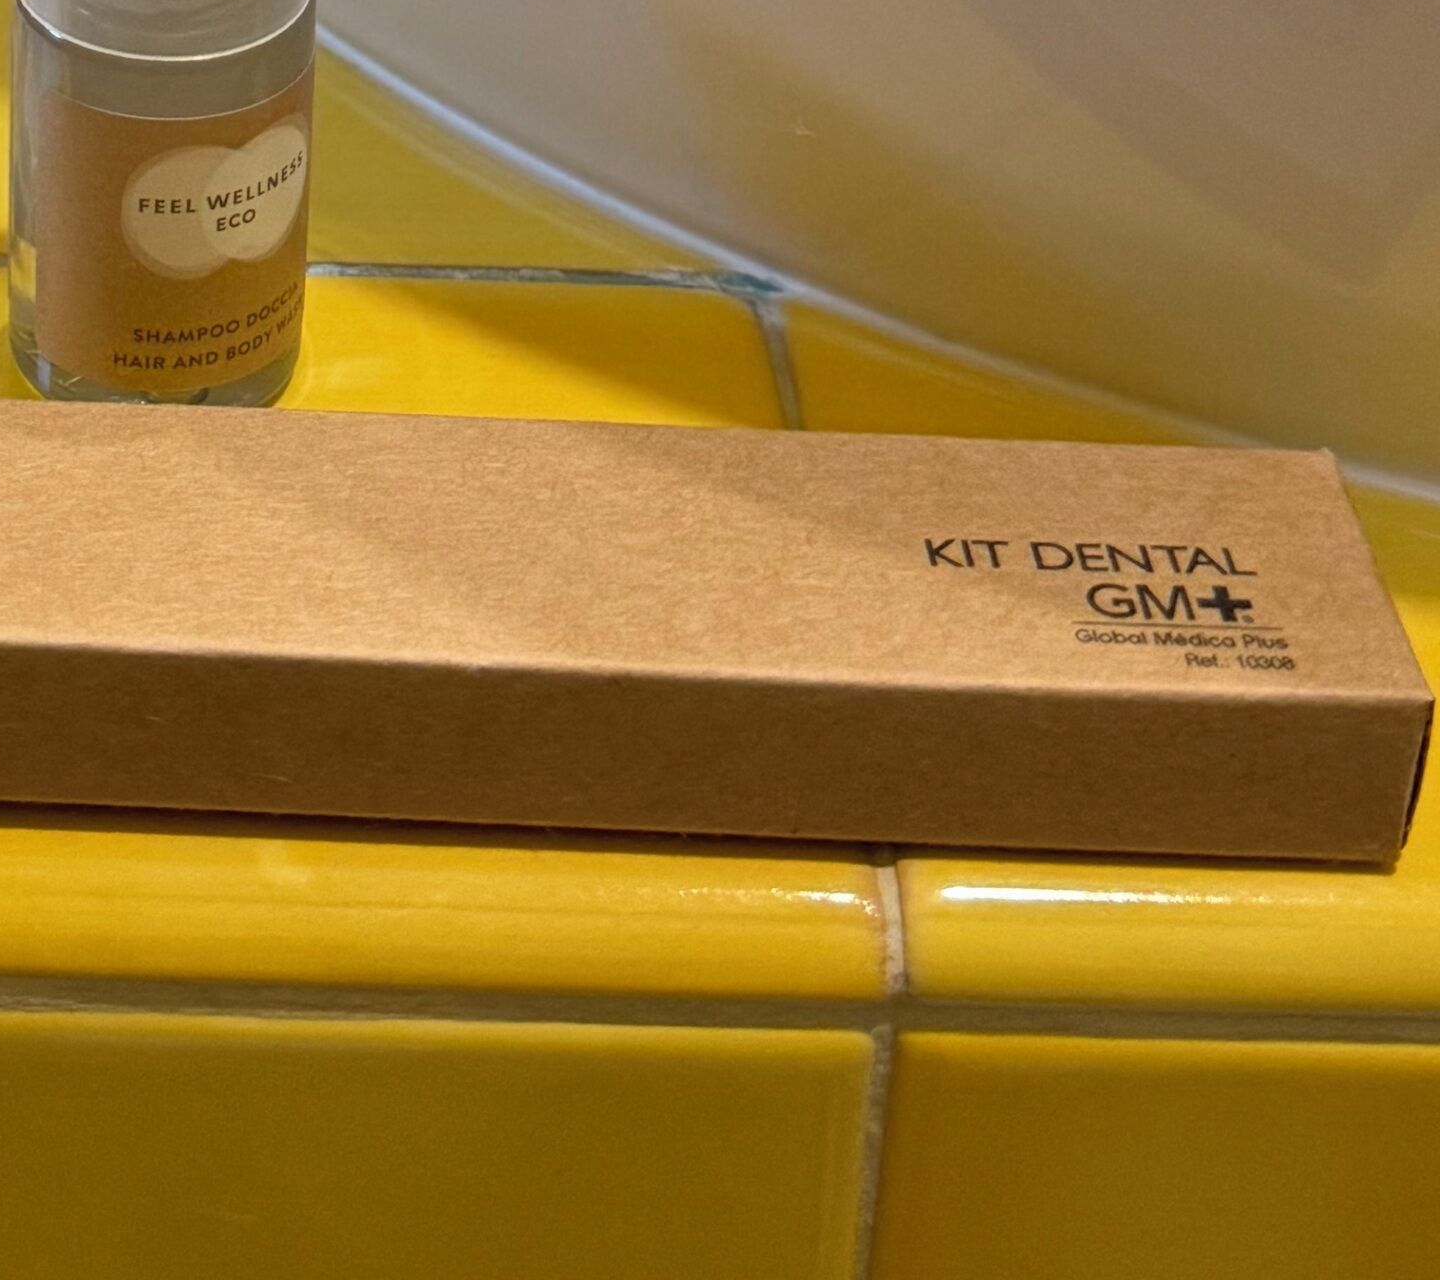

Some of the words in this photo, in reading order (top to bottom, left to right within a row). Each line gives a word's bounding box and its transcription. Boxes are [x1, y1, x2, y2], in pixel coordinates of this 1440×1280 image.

[139, 198, 197, 214] FEEL
[206, 150, 304, 212] WELLNESS
[216, 208, 257, 232] ECO
[133, 319, 240, 345] SHAMPOO
[113, 353, 166, 370] HAIR
[173, 351, 218, 370] AND
[226, 327, 273, 361] BODY
[924, 538, 1009, 569] KIT
[1030, 541, 1258, 577] DENTAL
[1074, 628, 1147, 646] Global
[1242, 633, 1289, 651] Plus
